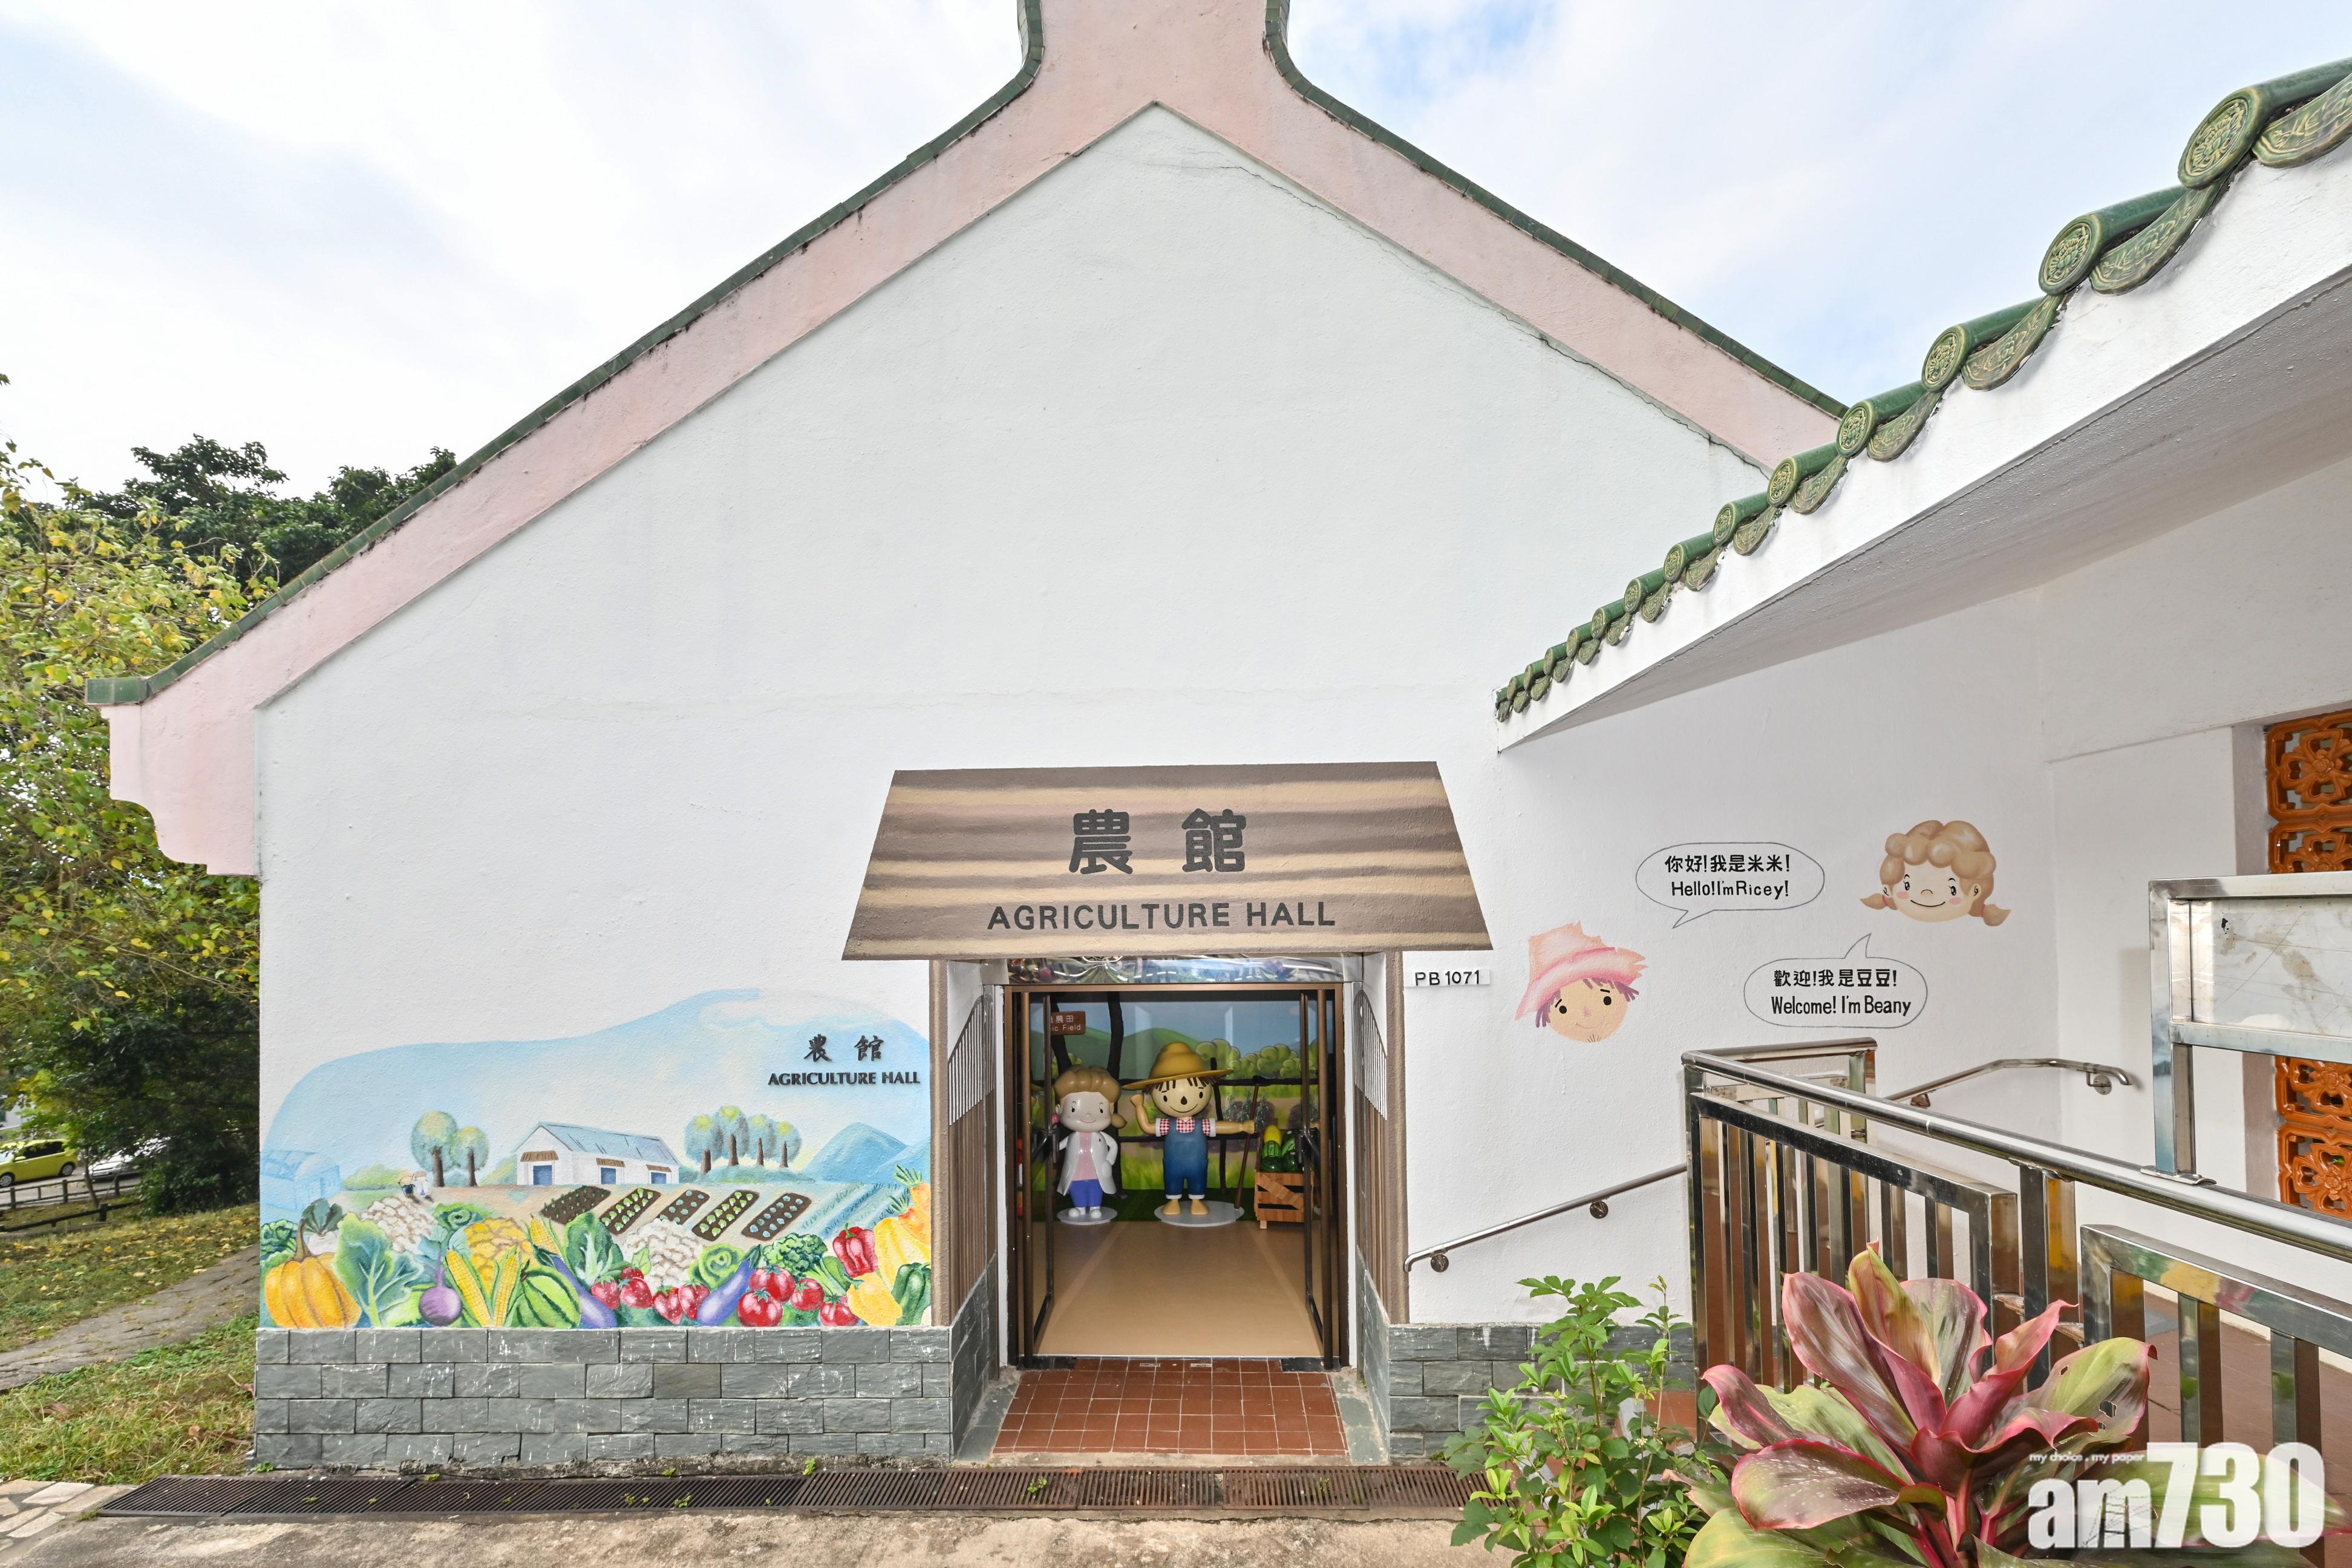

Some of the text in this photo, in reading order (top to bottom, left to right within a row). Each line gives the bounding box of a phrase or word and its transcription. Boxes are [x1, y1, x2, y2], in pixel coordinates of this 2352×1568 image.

[1069, 808, 1247, 875] 農館
[1664, 854, 1790, 872] 你好!我是米米!
[987, 901, 1335, 930] AGRICULTURE HALL
[1773, 969, 1897, 987] 歡迎!我是豆豆!
[1771, 995, 1912, 1017] Welcome! I'm Beany
[1051, 1015, 1074, 1024] 農田
[803, 1033, 884, 1062] 農館
[768, 1071, 921, 1085] AGRICULTURE HALL
